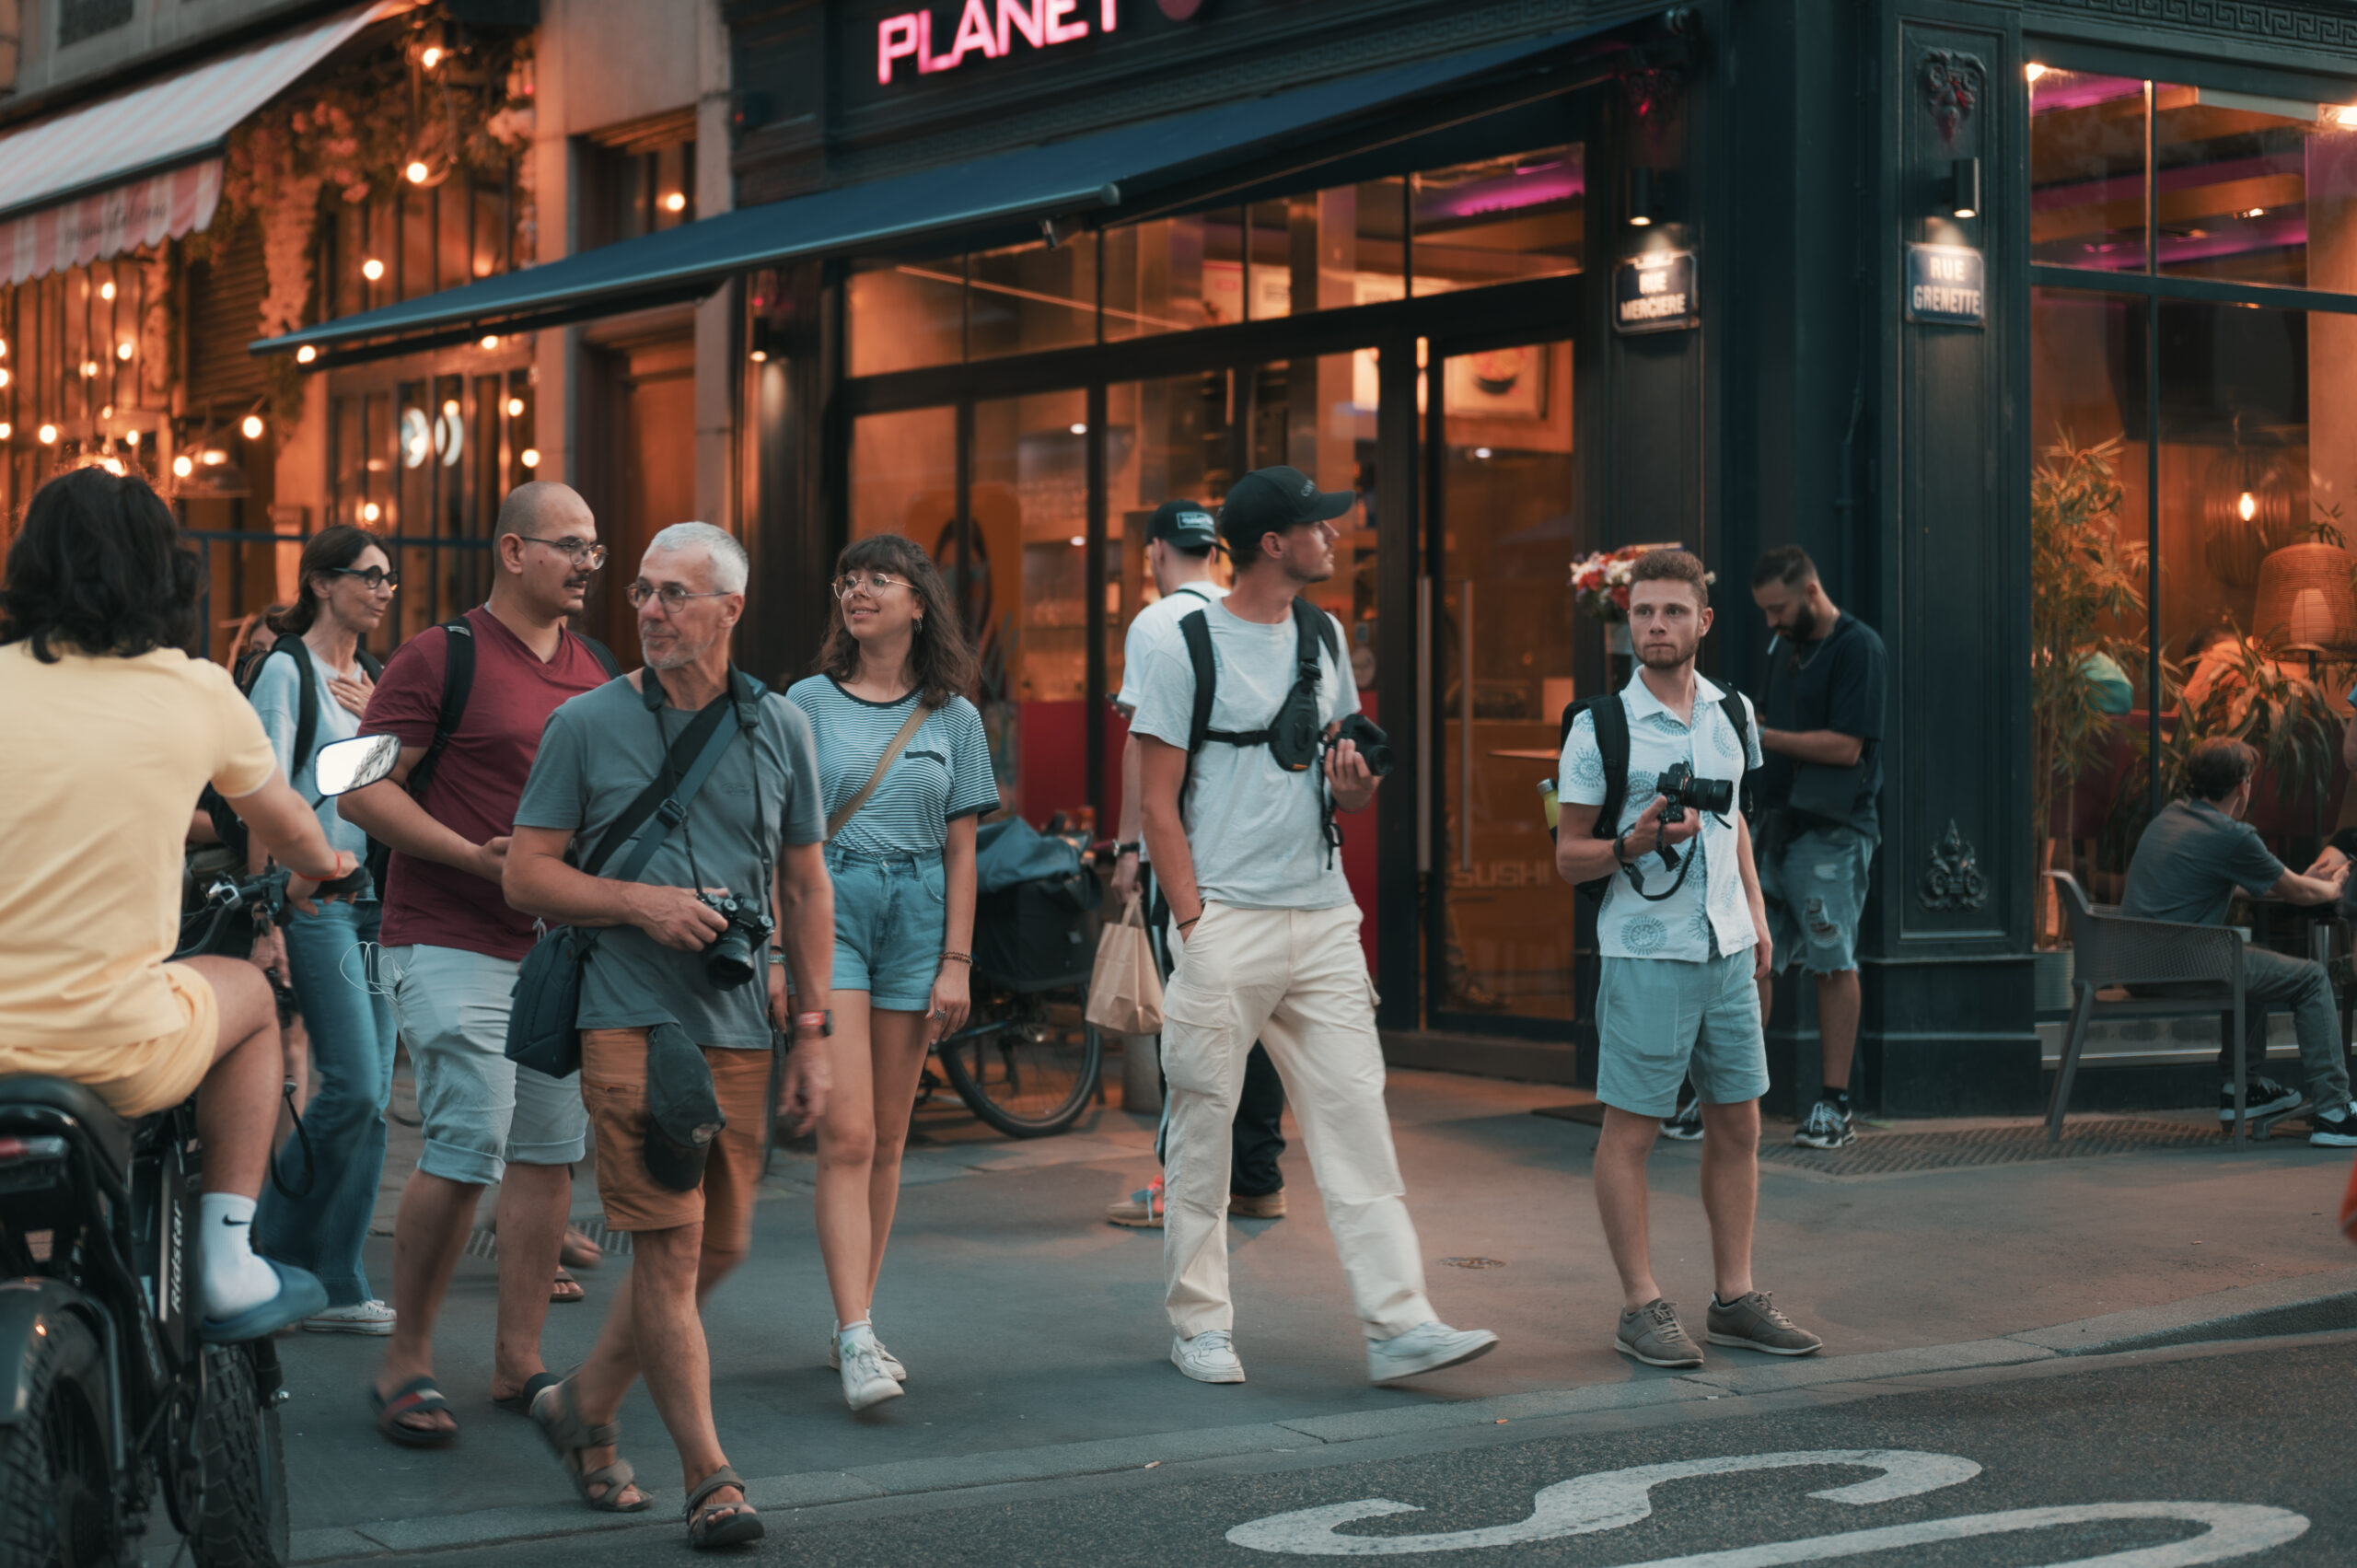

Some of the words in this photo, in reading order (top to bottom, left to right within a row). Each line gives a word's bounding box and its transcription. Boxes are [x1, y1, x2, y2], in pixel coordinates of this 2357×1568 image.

[1930, 257, 1967, 282] RUE
[1912, 285, 1981, 315] GRENETTE
[170, 1199, 183, 1315] Ridstar
